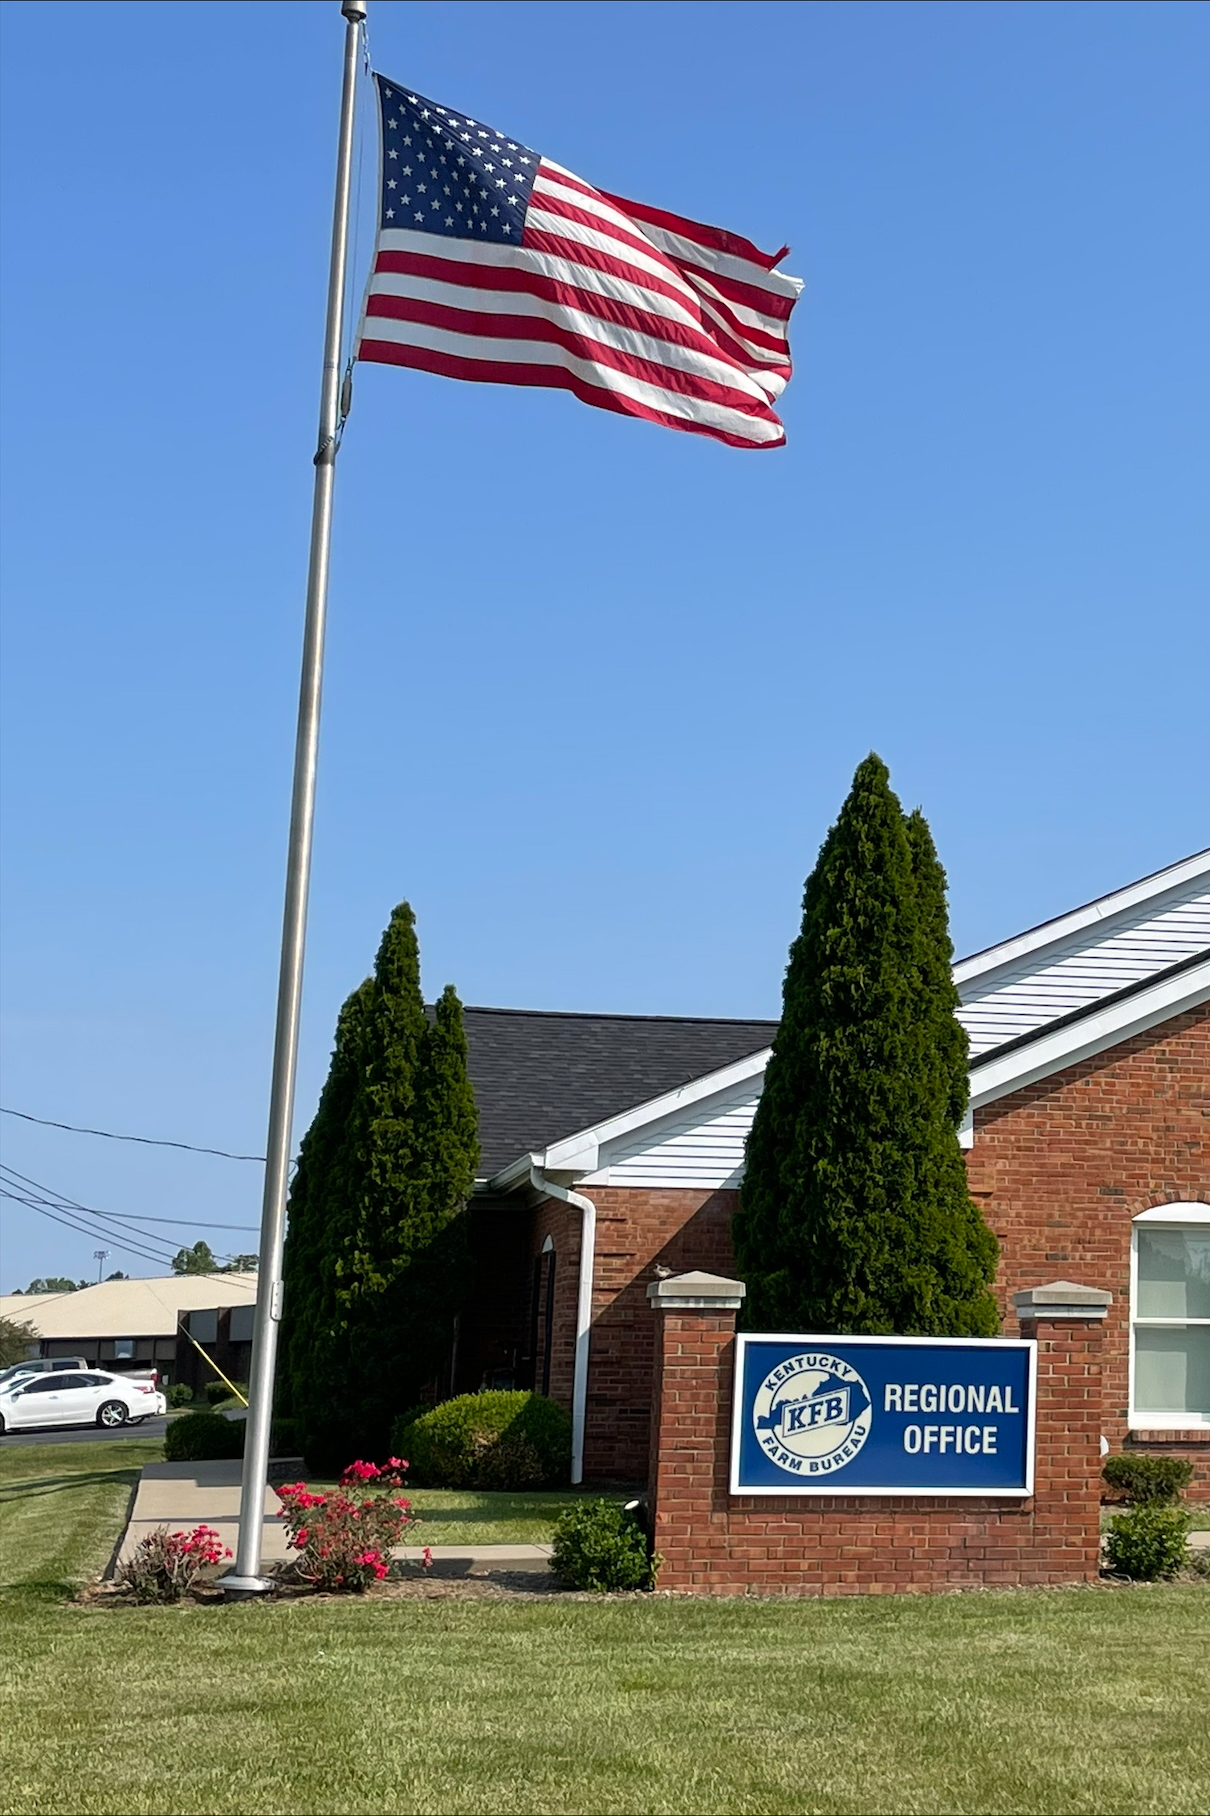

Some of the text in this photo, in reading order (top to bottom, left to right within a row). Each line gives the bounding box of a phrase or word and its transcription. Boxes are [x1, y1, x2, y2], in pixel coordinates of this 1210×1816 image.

[765, 1356, 853, 1391] KENTUCKY
[787, 1398, 843, 1432] KFB
[884, 1384, 1019, 1413] REGIONAL
[762, 1425, 866, 1472] FARM BUREAU
[904, 1425, 997, 1454] OFFICE
